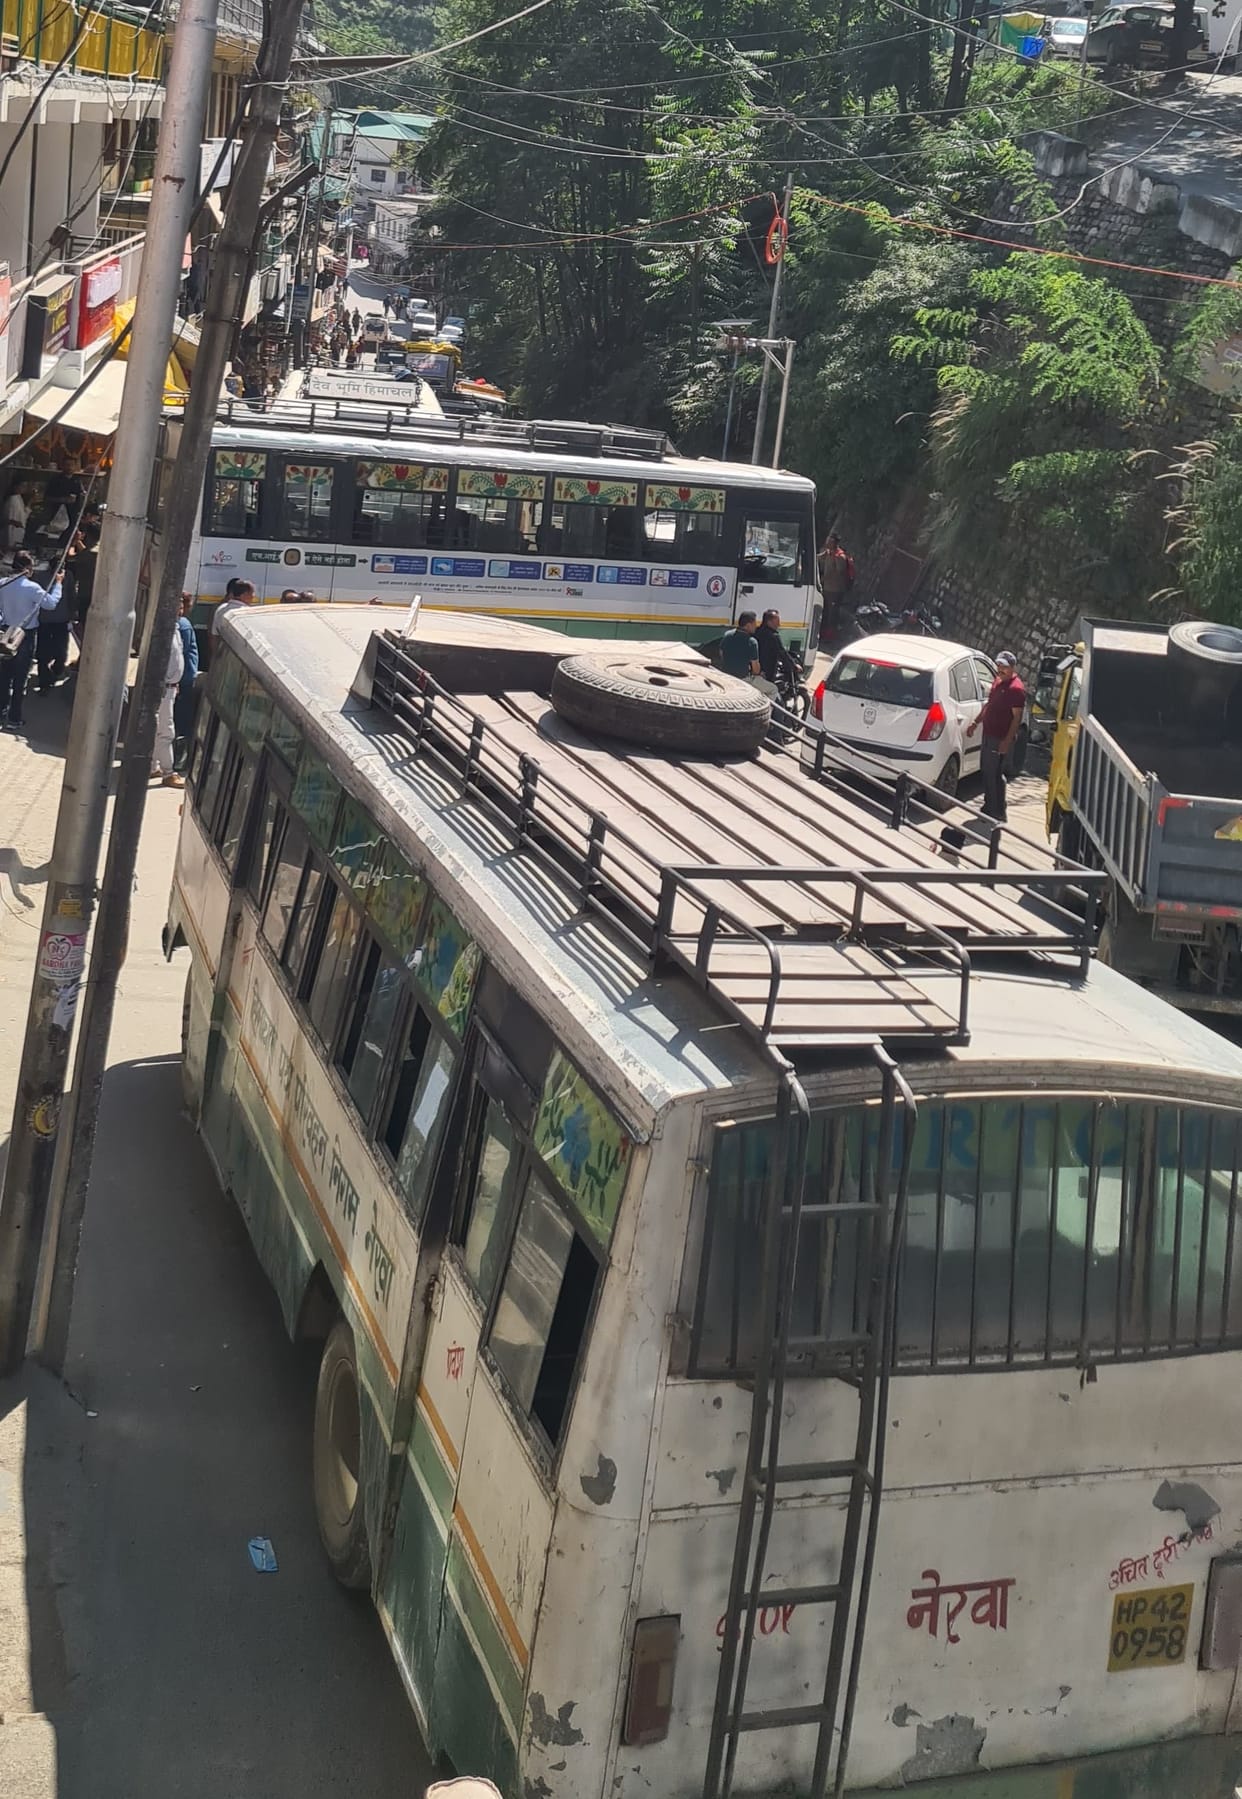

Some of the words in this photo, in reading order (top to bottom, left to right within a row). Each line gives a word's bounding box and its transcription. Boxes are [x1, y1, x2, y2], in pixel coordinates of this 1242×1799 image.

[312, 376, 331, 391] देव
[336, 381, 361, 396] भूमि
[364, 382, 413, 398] हिमाचल
[1108, 1555, 1149, 1591] उचित
[907, 1569, 1017, 1643] नेरवा
[1111, 1624, 1186, 1661] 0958
